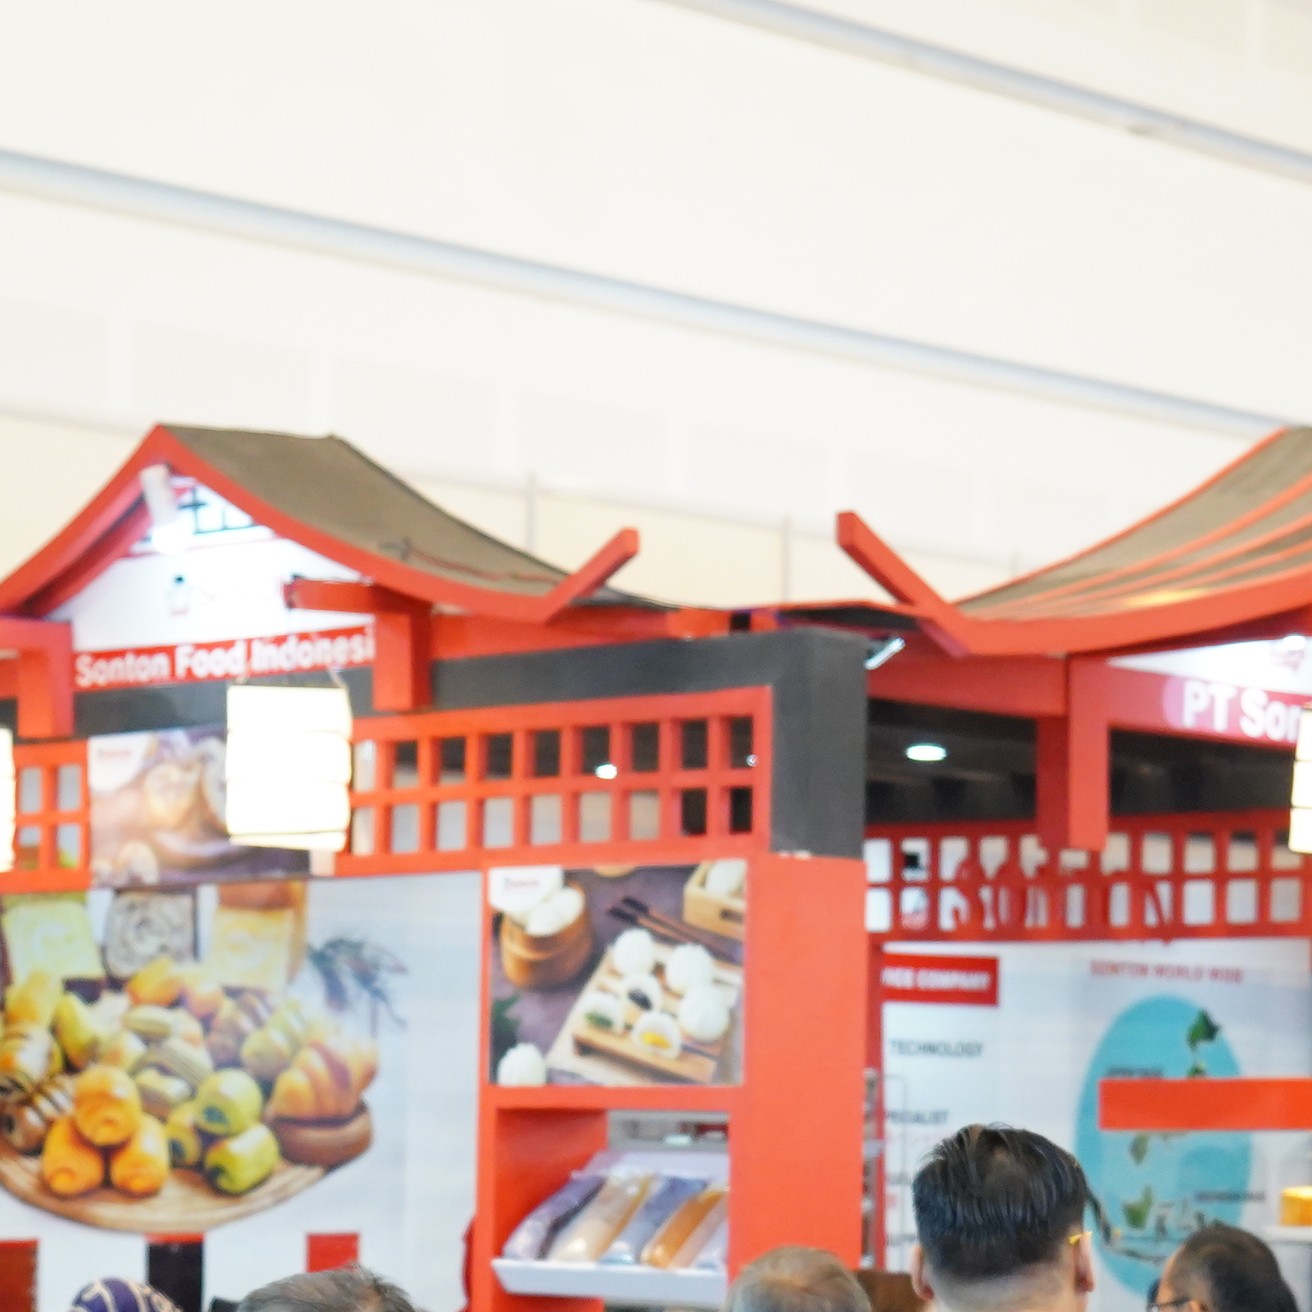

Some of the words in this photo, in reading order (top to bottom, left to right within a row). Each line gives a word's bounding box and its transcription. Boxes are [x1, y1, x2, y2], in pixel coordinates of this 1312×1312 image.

[76, 653, 170, 687] Sonton
[174, 642, 244, 677] Food
[252, 628, 375, 668] Indonesi
[1183, 681, 1238, 732] PT
